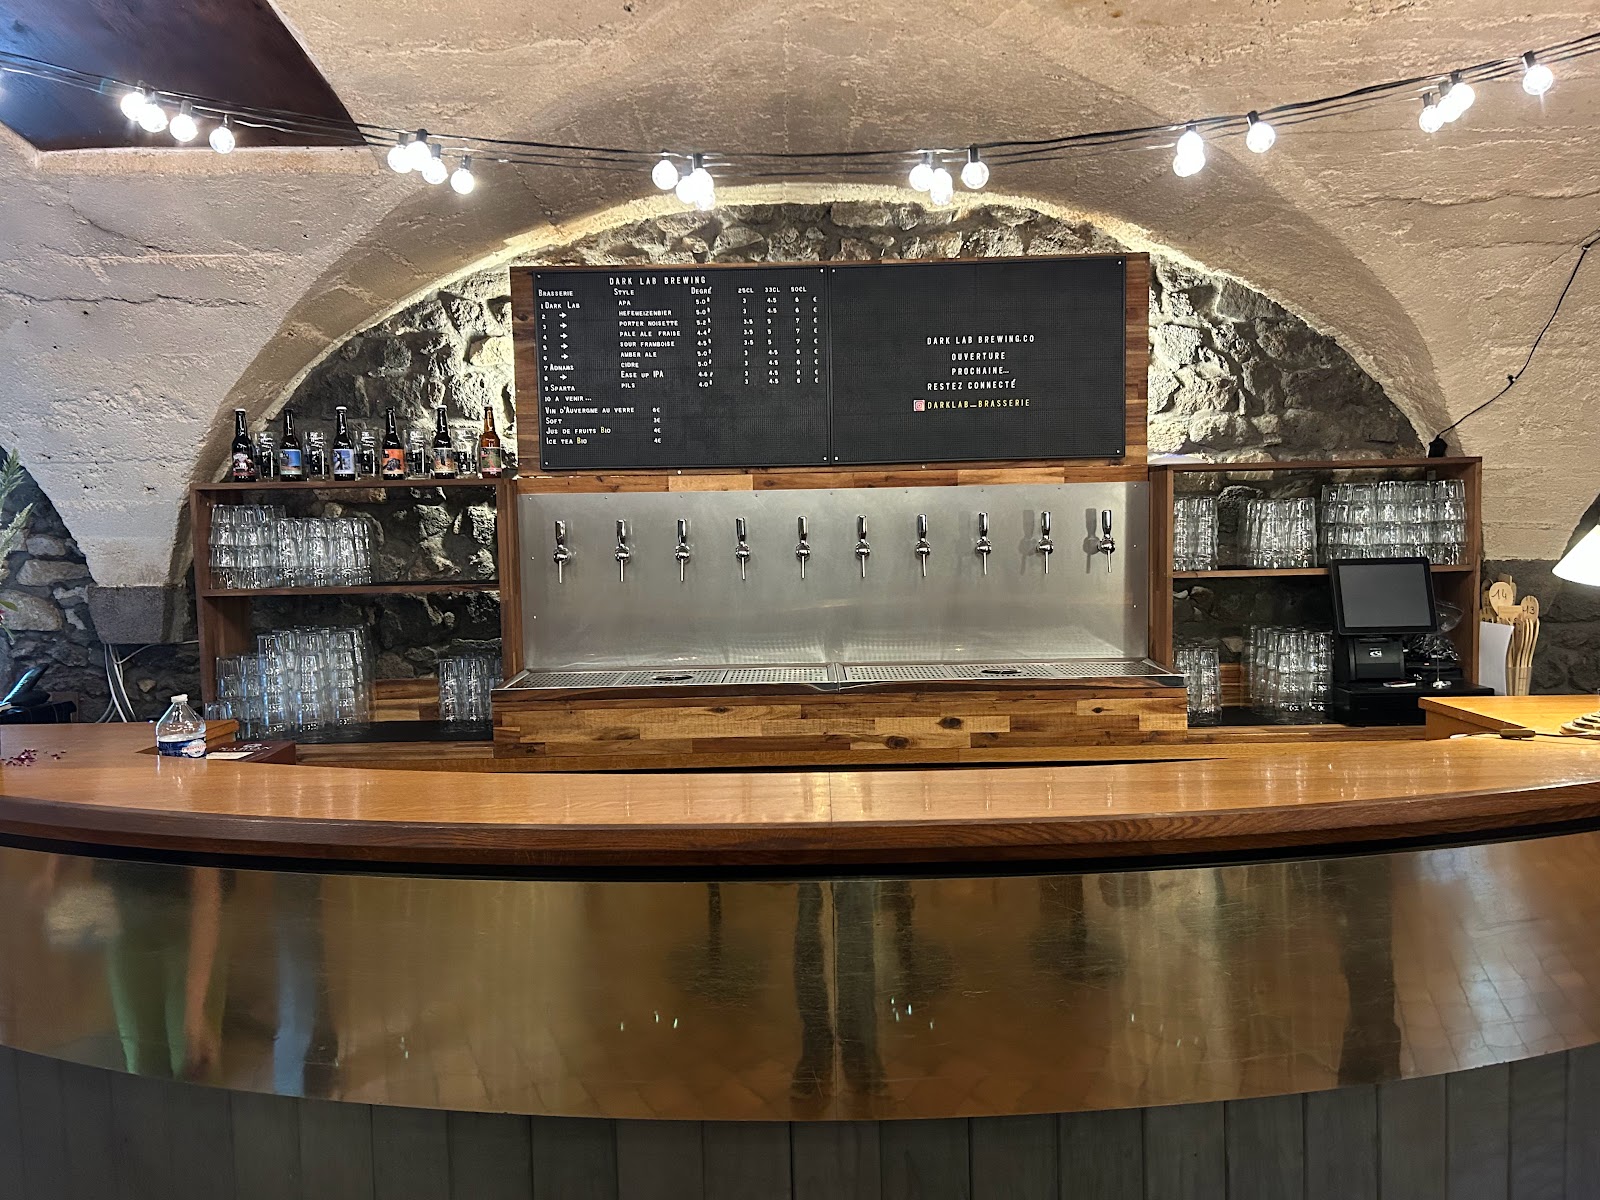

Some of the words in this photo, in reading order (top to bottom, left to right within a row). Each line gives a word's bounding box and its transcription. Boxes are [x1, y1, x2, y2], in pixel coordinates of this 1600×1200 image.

[610, 278, 632, 286] DARK
[640, 277, 656, 285] LAB
[664, 276, 705, 284] BREWING
[927, 337, 950, 345] DARK
[956, 336, 972, 344] LAB
[952, 352, 1005, 360] OUVERTURE
[928, 382, 962, 390] RESTEZ
[968, 379, 1016, 389] CONNECTÉ
